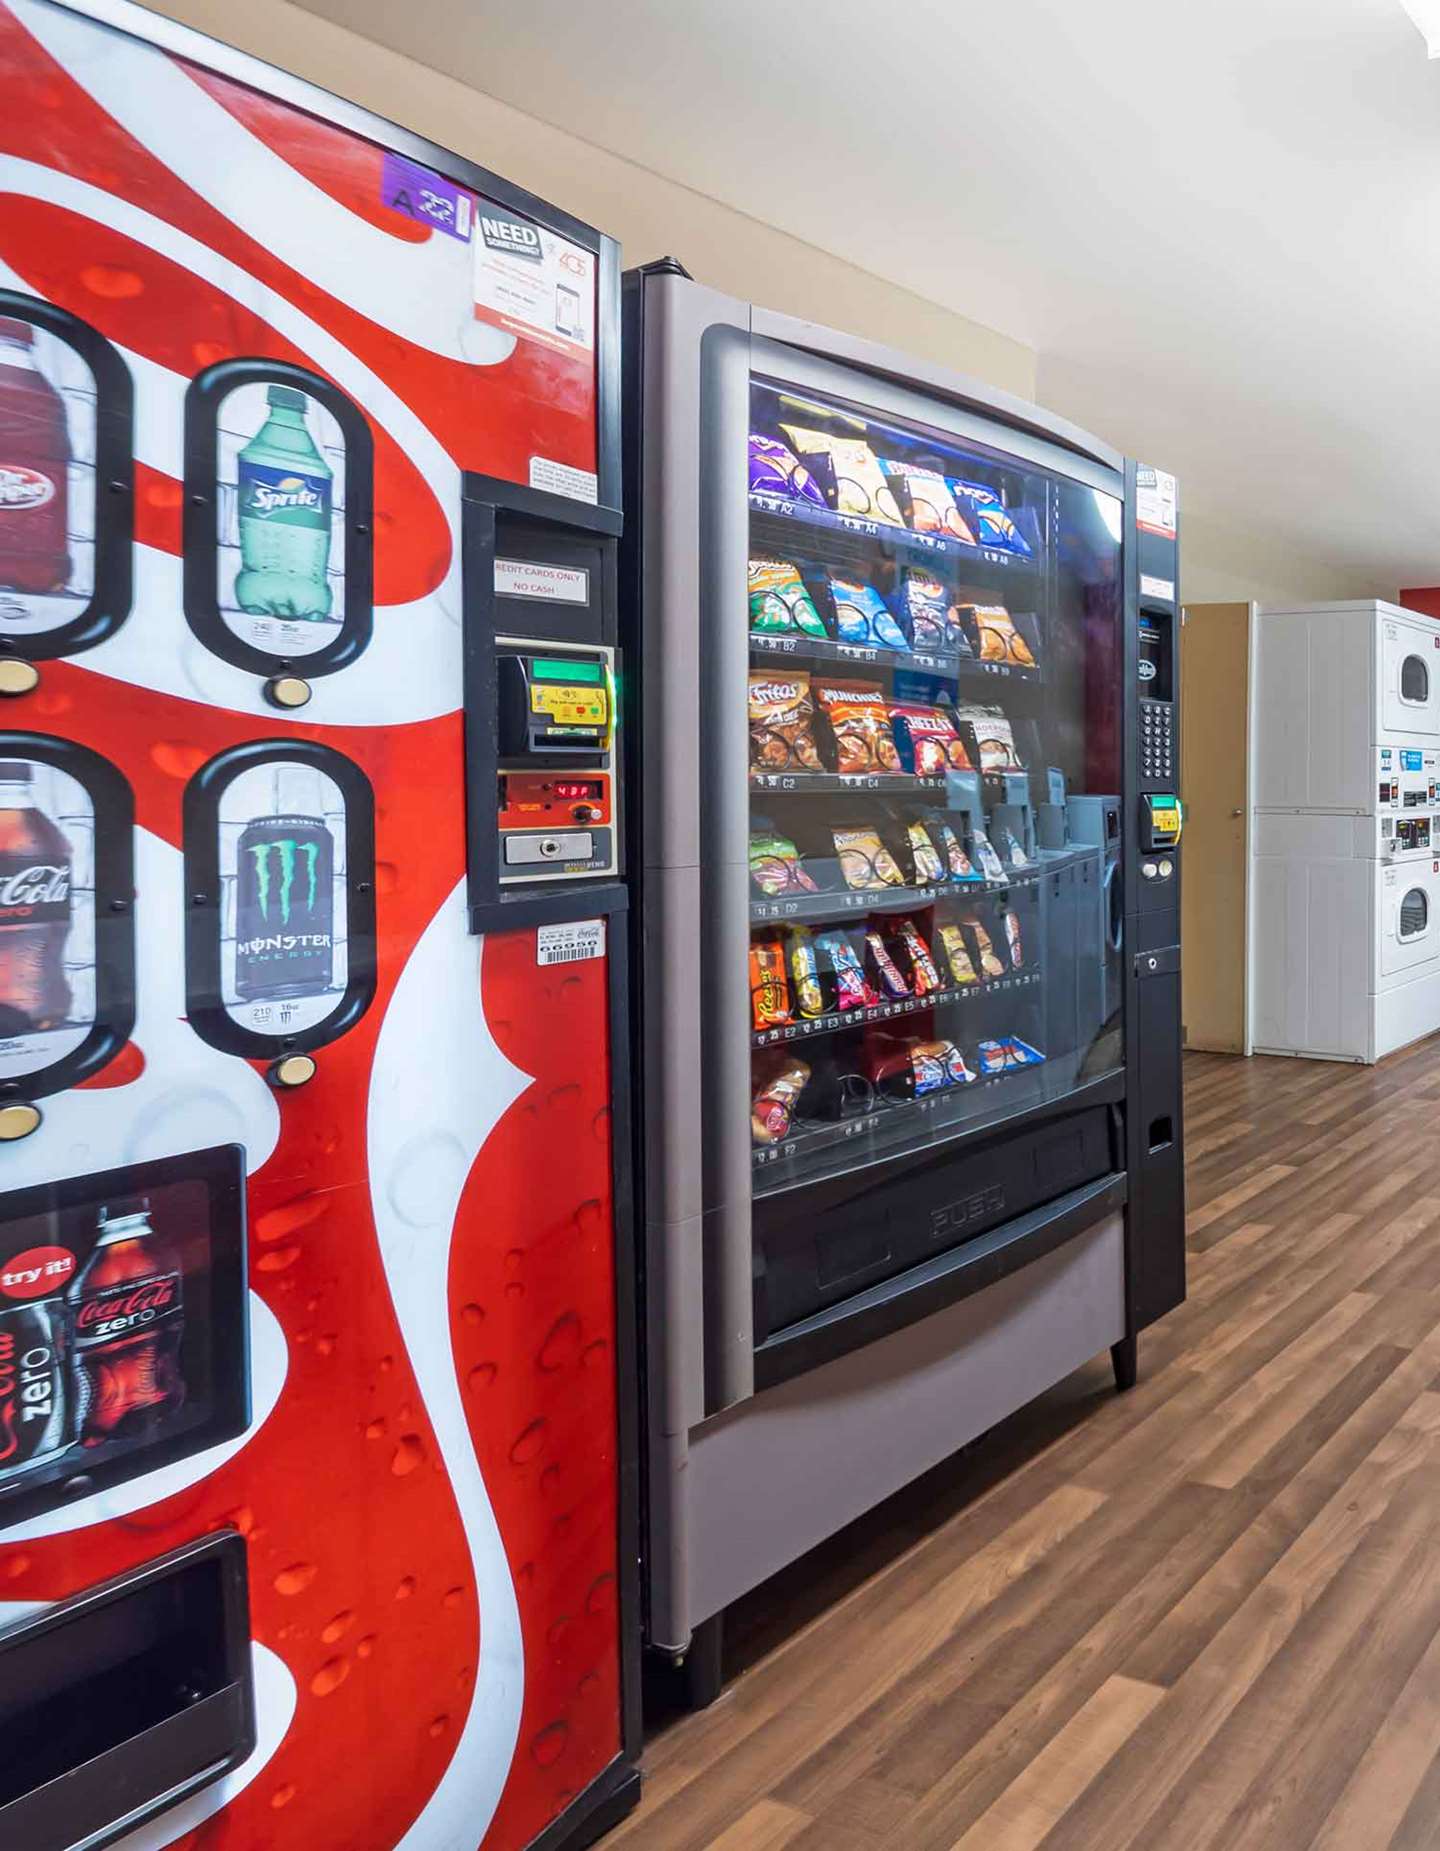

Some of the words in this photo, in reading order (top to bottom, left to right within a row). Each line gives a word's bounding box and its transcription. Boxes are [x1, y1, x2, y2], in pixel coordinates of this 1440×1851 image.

[481, 216, 538, 246] NEED
[250, 486, 320, 514] Sprite
[780, 501, 793, 515] A2
[525, 565, 554, 579] CARDS
[556, 570, 580, 582] ONLY
[514, 582, 528, 591] NO
[530, 583, 554, 594] CASH
[750, 681, 798, 705] Fritos
[782, 778, 795, 789] C2
[237, 933, 332, 956] MONSTER
[867, 1010, 878, 1019] E4
[904, 1001, 914, 1011] E5
[827, 1018, 838, 1028] E3
[784, 1027, 796, 1037] E2
[1, 1266, 42, 1288] try
[46, 1256, 73, 1274] it!
[95, 1308, 157, 1336] zero
[20, 1346, 52, 1423] zero
